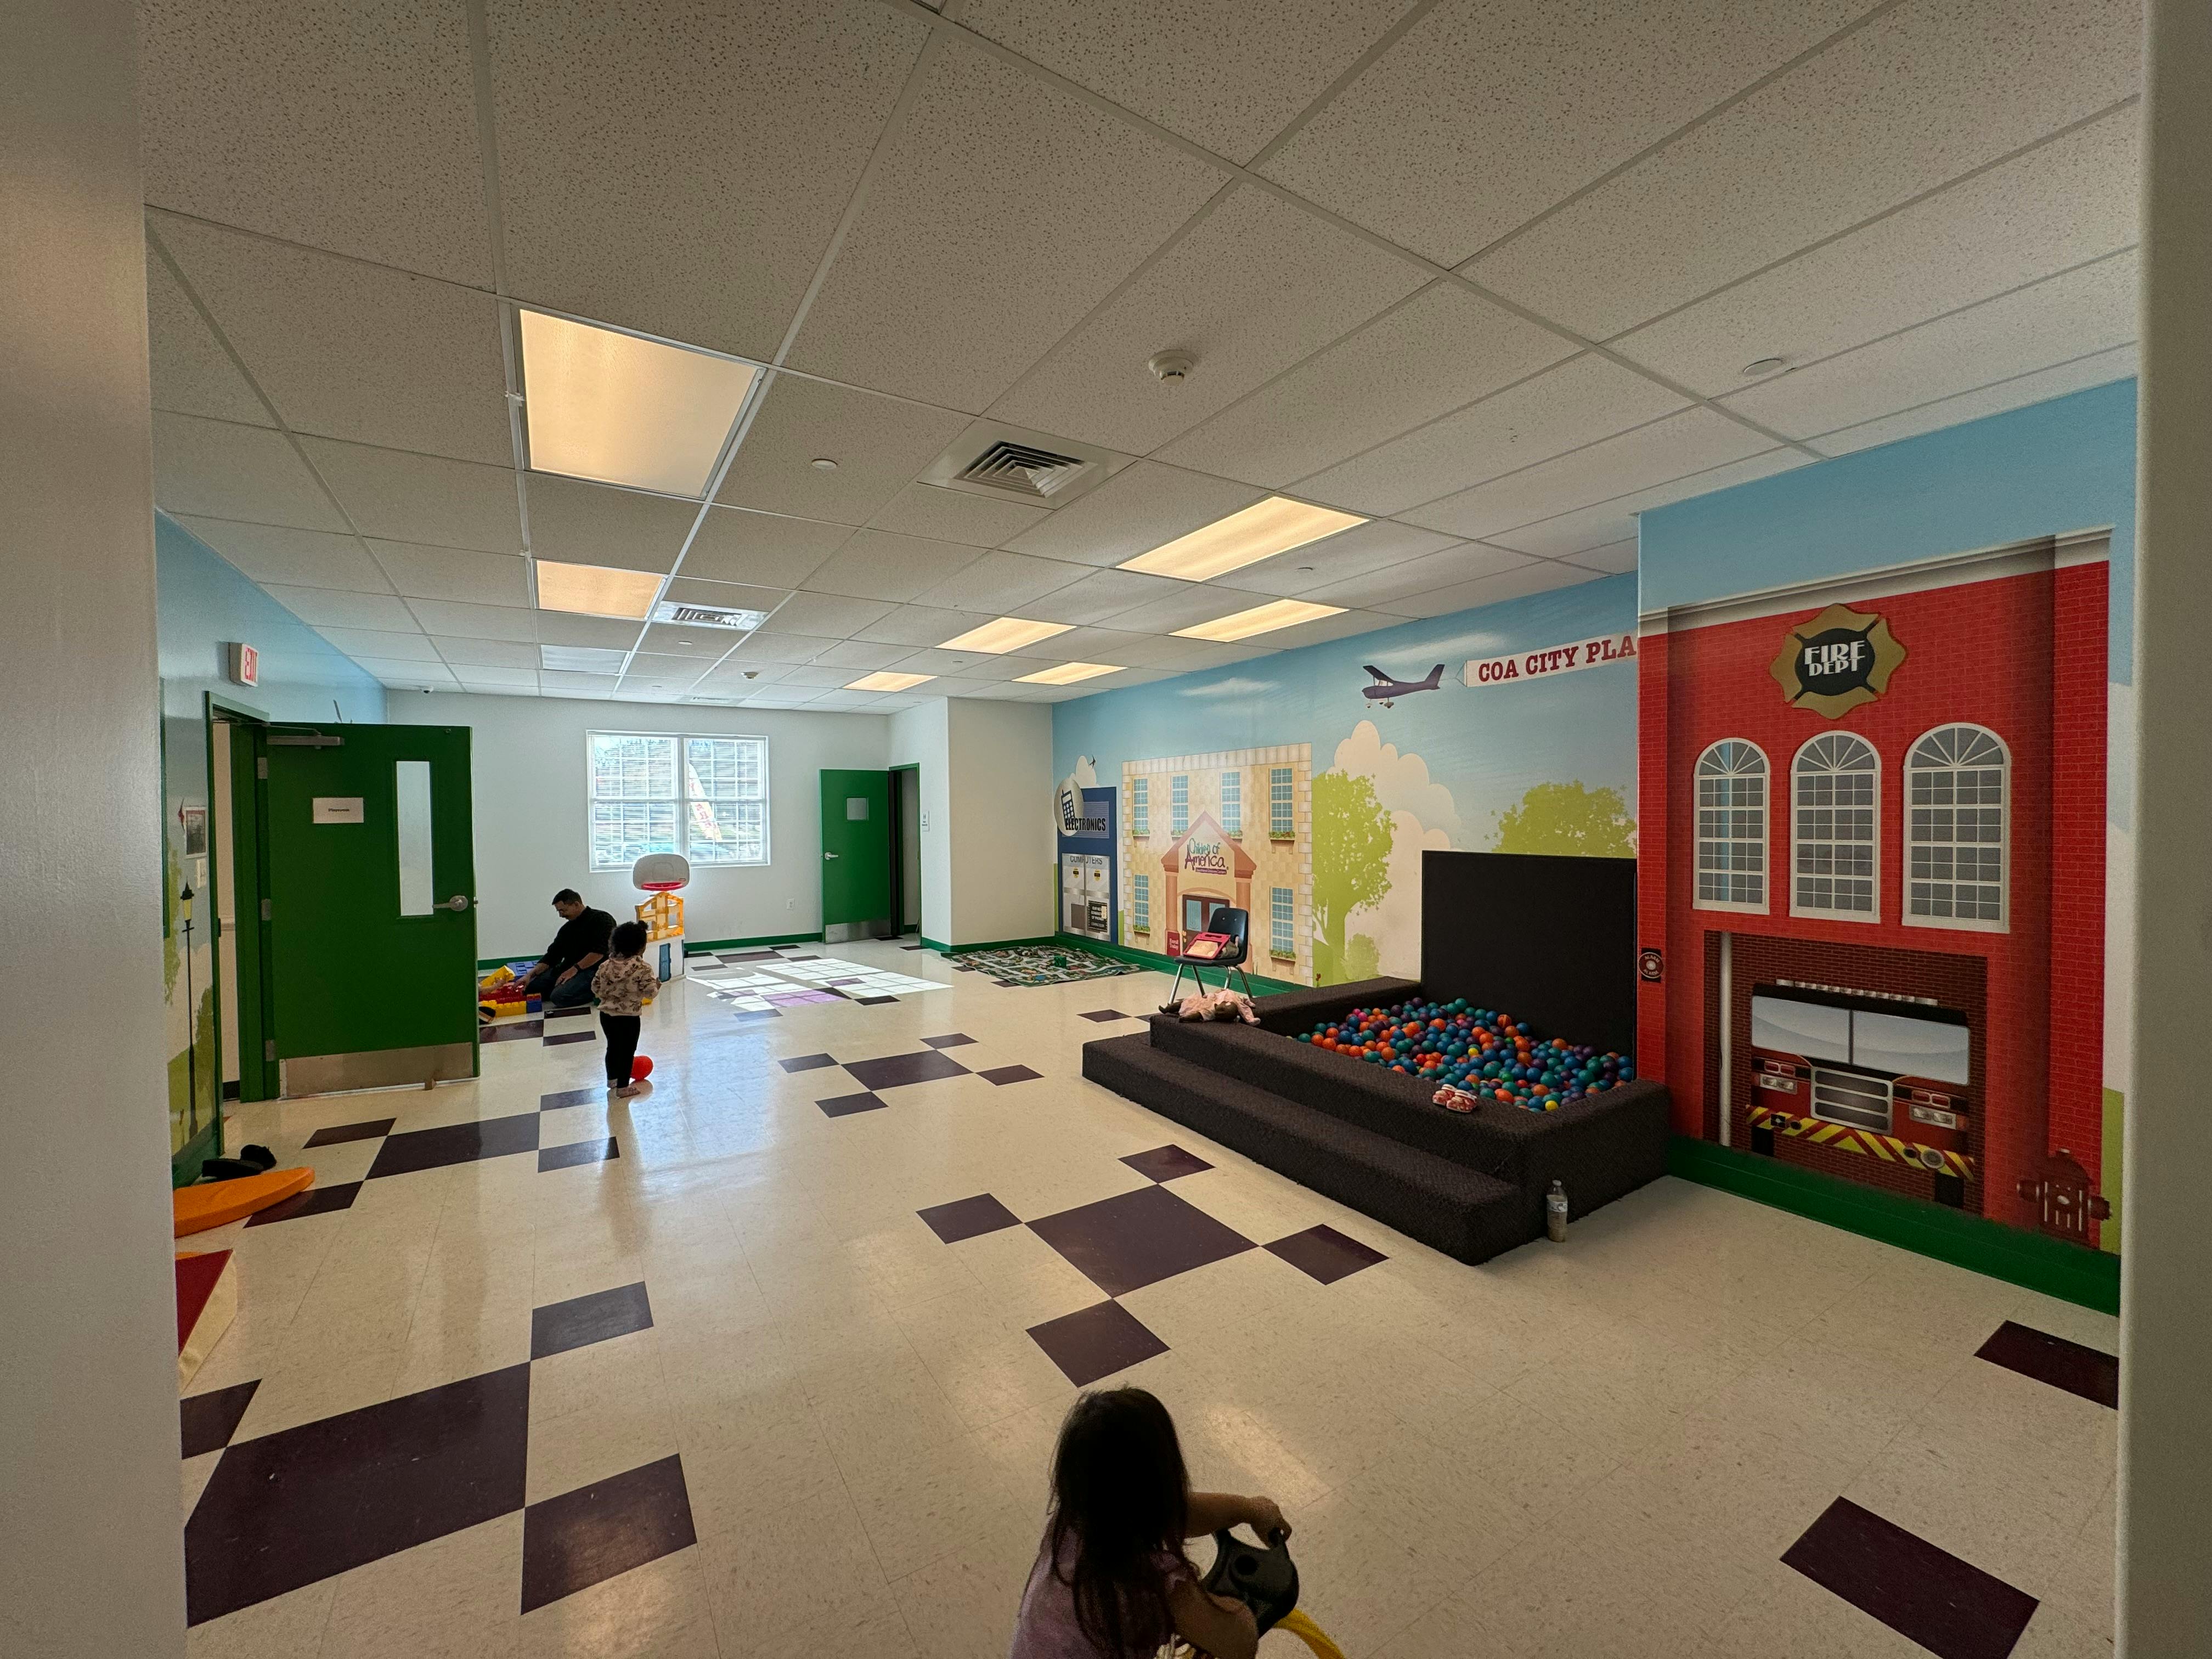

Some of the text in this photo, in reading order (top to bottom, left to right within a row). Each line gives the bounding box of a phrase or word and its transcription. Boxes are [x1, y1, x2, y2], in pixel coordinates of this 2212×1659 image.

[245, 647, 258, 682] EXIT
[1478, 635, 1638, 682] COA CITY PLA
[1804, 640, 1866, 665] FIRE
[1809, 658, 1861, 676] DEPT
[1065, 817, 1106, 832] ELECTRONICS
[1184, 844, 1226, 871] America
[1189, 837, 1221, 855] Children of
